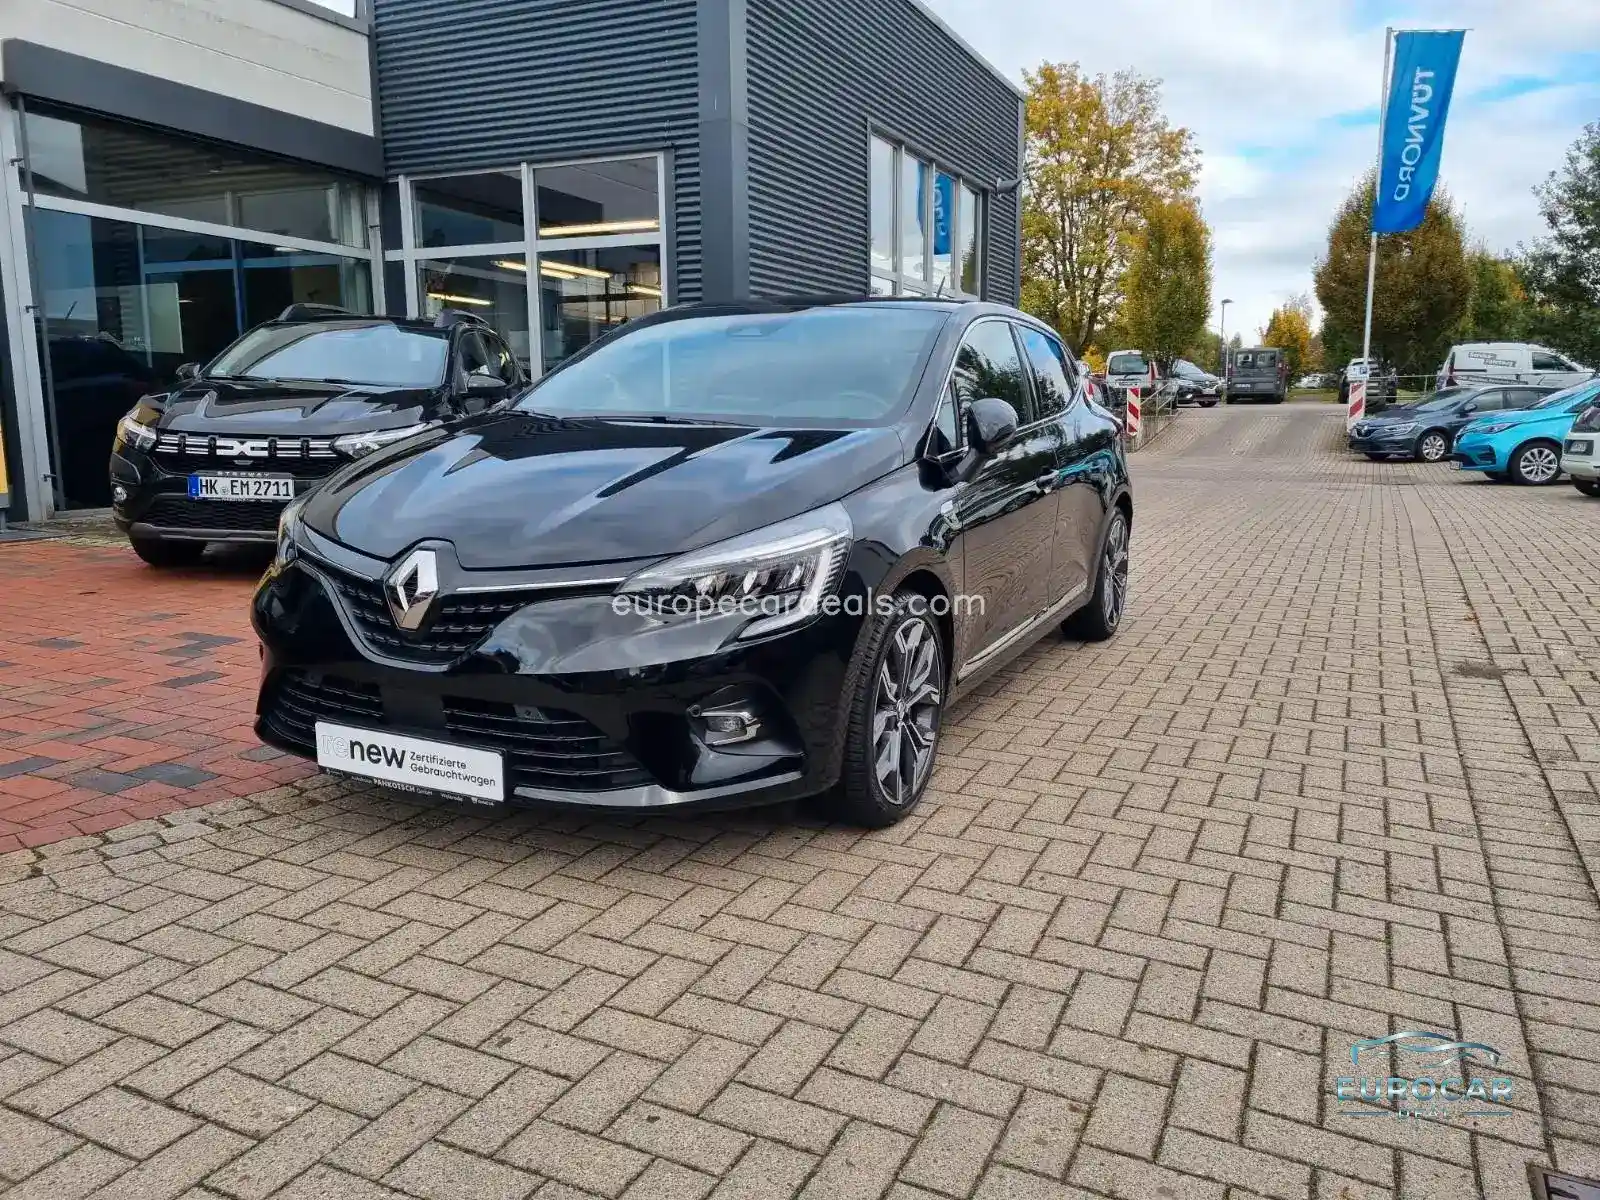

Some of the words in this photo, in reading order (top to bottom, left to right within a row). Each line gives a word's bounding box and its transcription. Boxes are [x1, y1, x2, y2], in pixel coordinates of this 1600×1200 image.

[200, 478, 218, 495] HK
[230, 479, 250, 495] EM
[253, 480, 291, 496] 2711
[409, 751, 467, 770] Zertifizierte
[410, 763, 496, 787] Gebrauchtwagen
